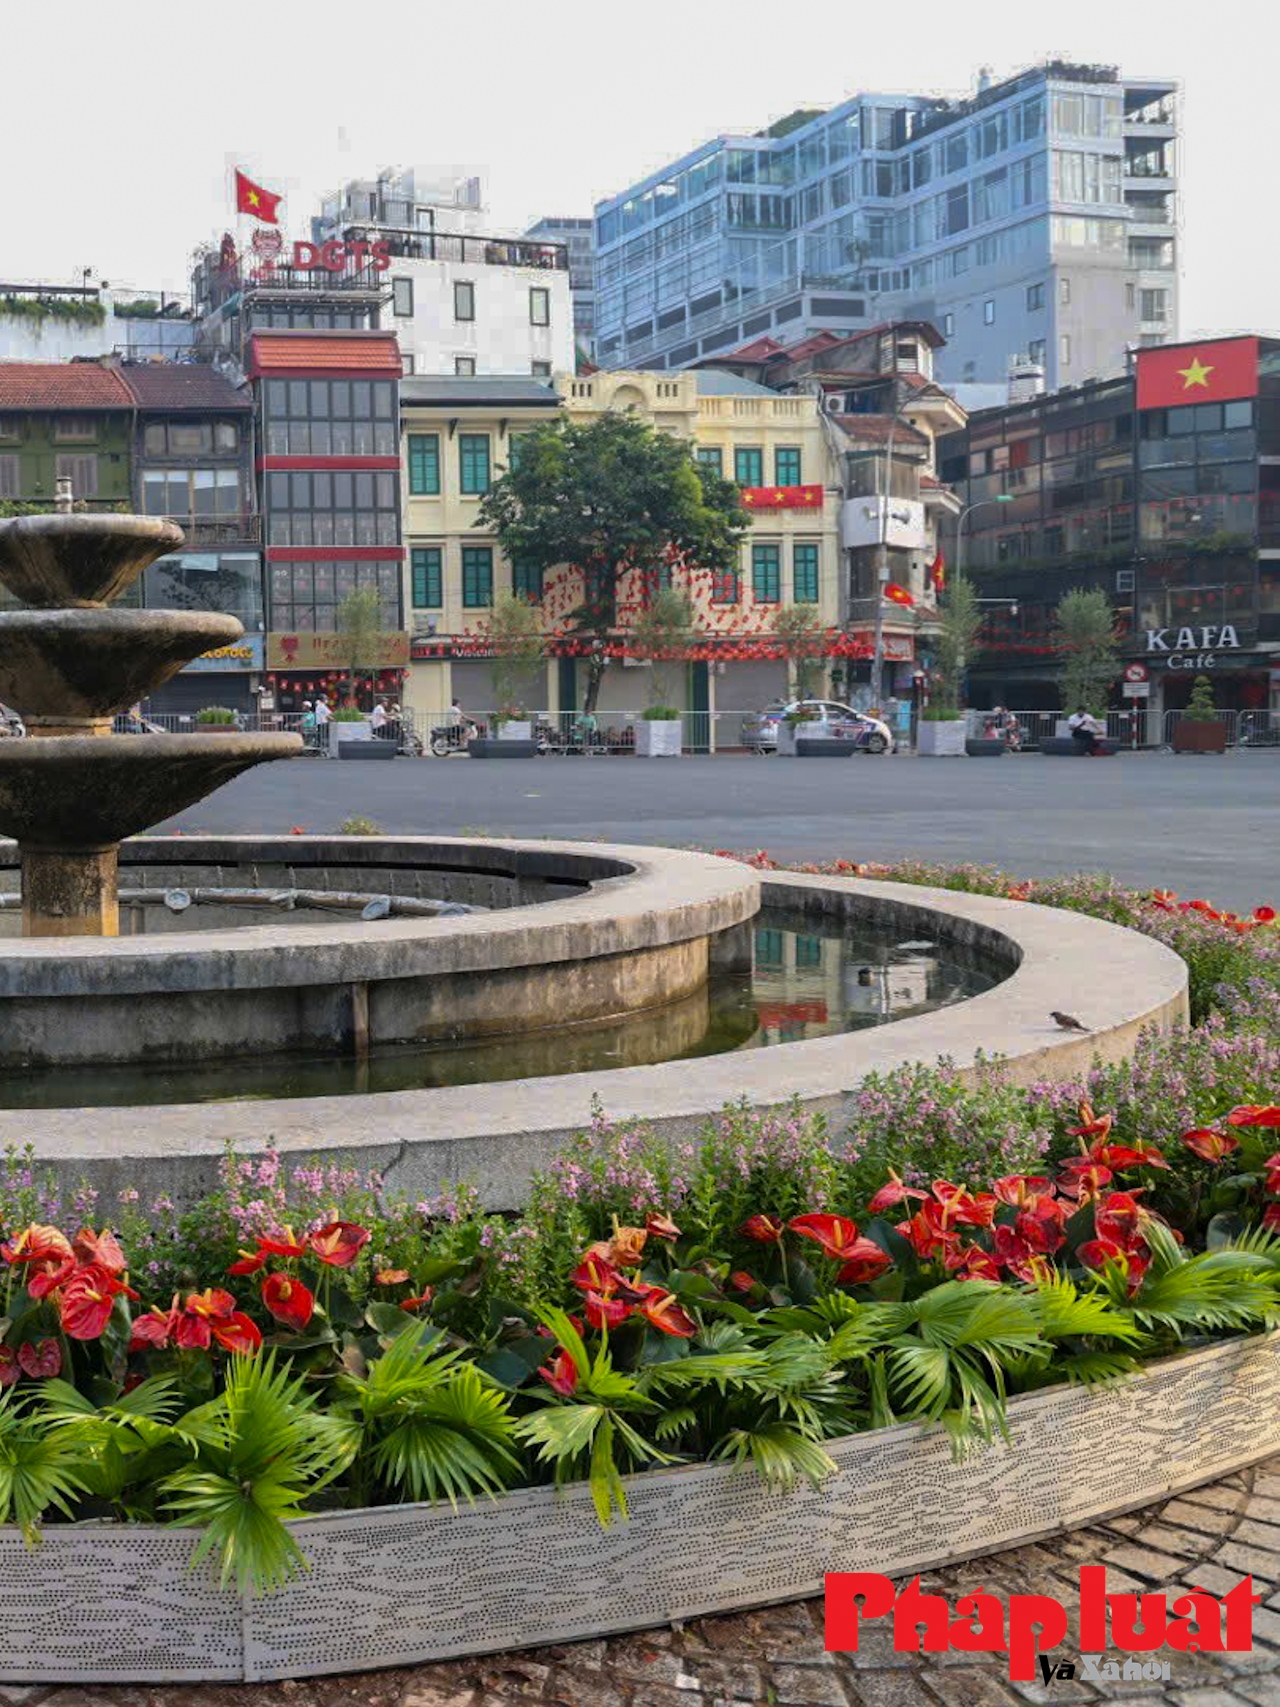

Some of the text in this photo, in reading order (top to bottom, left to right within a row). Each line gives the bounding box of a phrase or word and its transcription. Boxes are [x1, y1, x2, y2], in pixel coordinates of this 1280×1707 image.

[293, 240, 391, 272] DGTS
[1145, 624, 1242, 652] KAFA
[1166, 653, 1217, 670] Café
